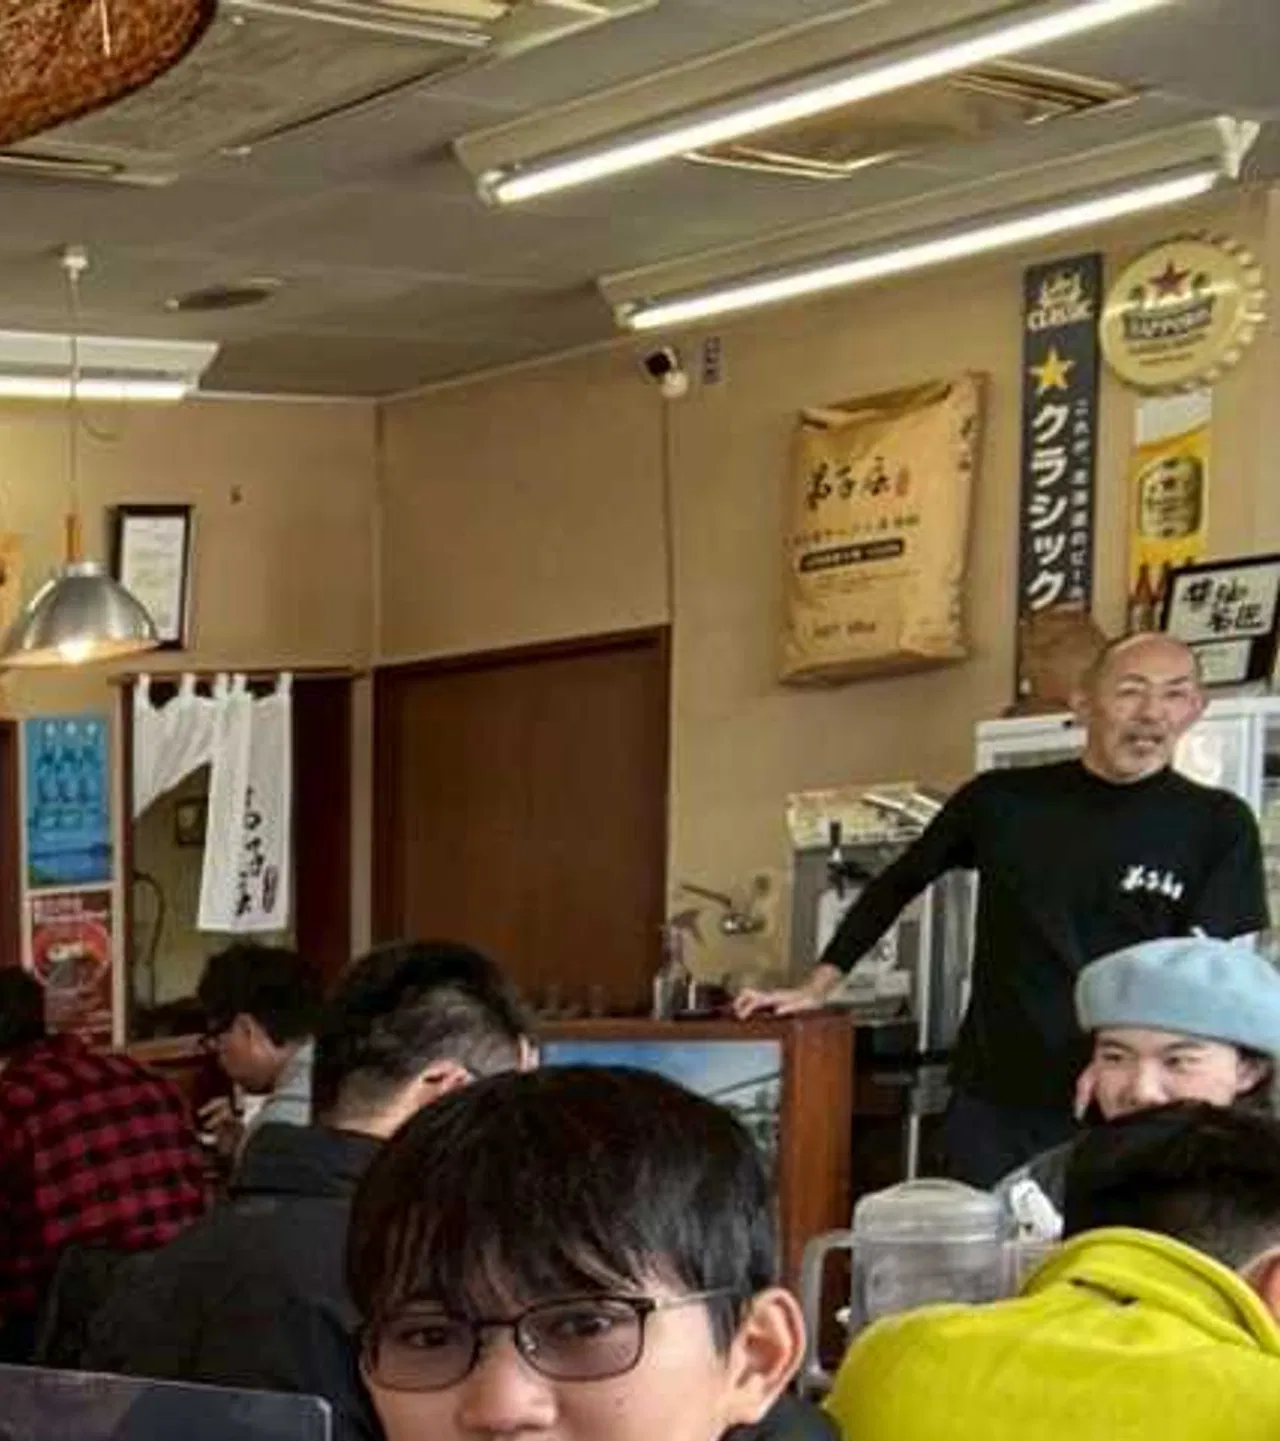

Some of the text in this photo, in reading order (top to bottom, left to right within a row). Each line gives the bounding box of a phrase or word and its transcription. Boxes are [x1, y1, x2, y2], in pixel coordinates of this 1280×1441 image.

[1026, 402, 1070, 612] クラシック
